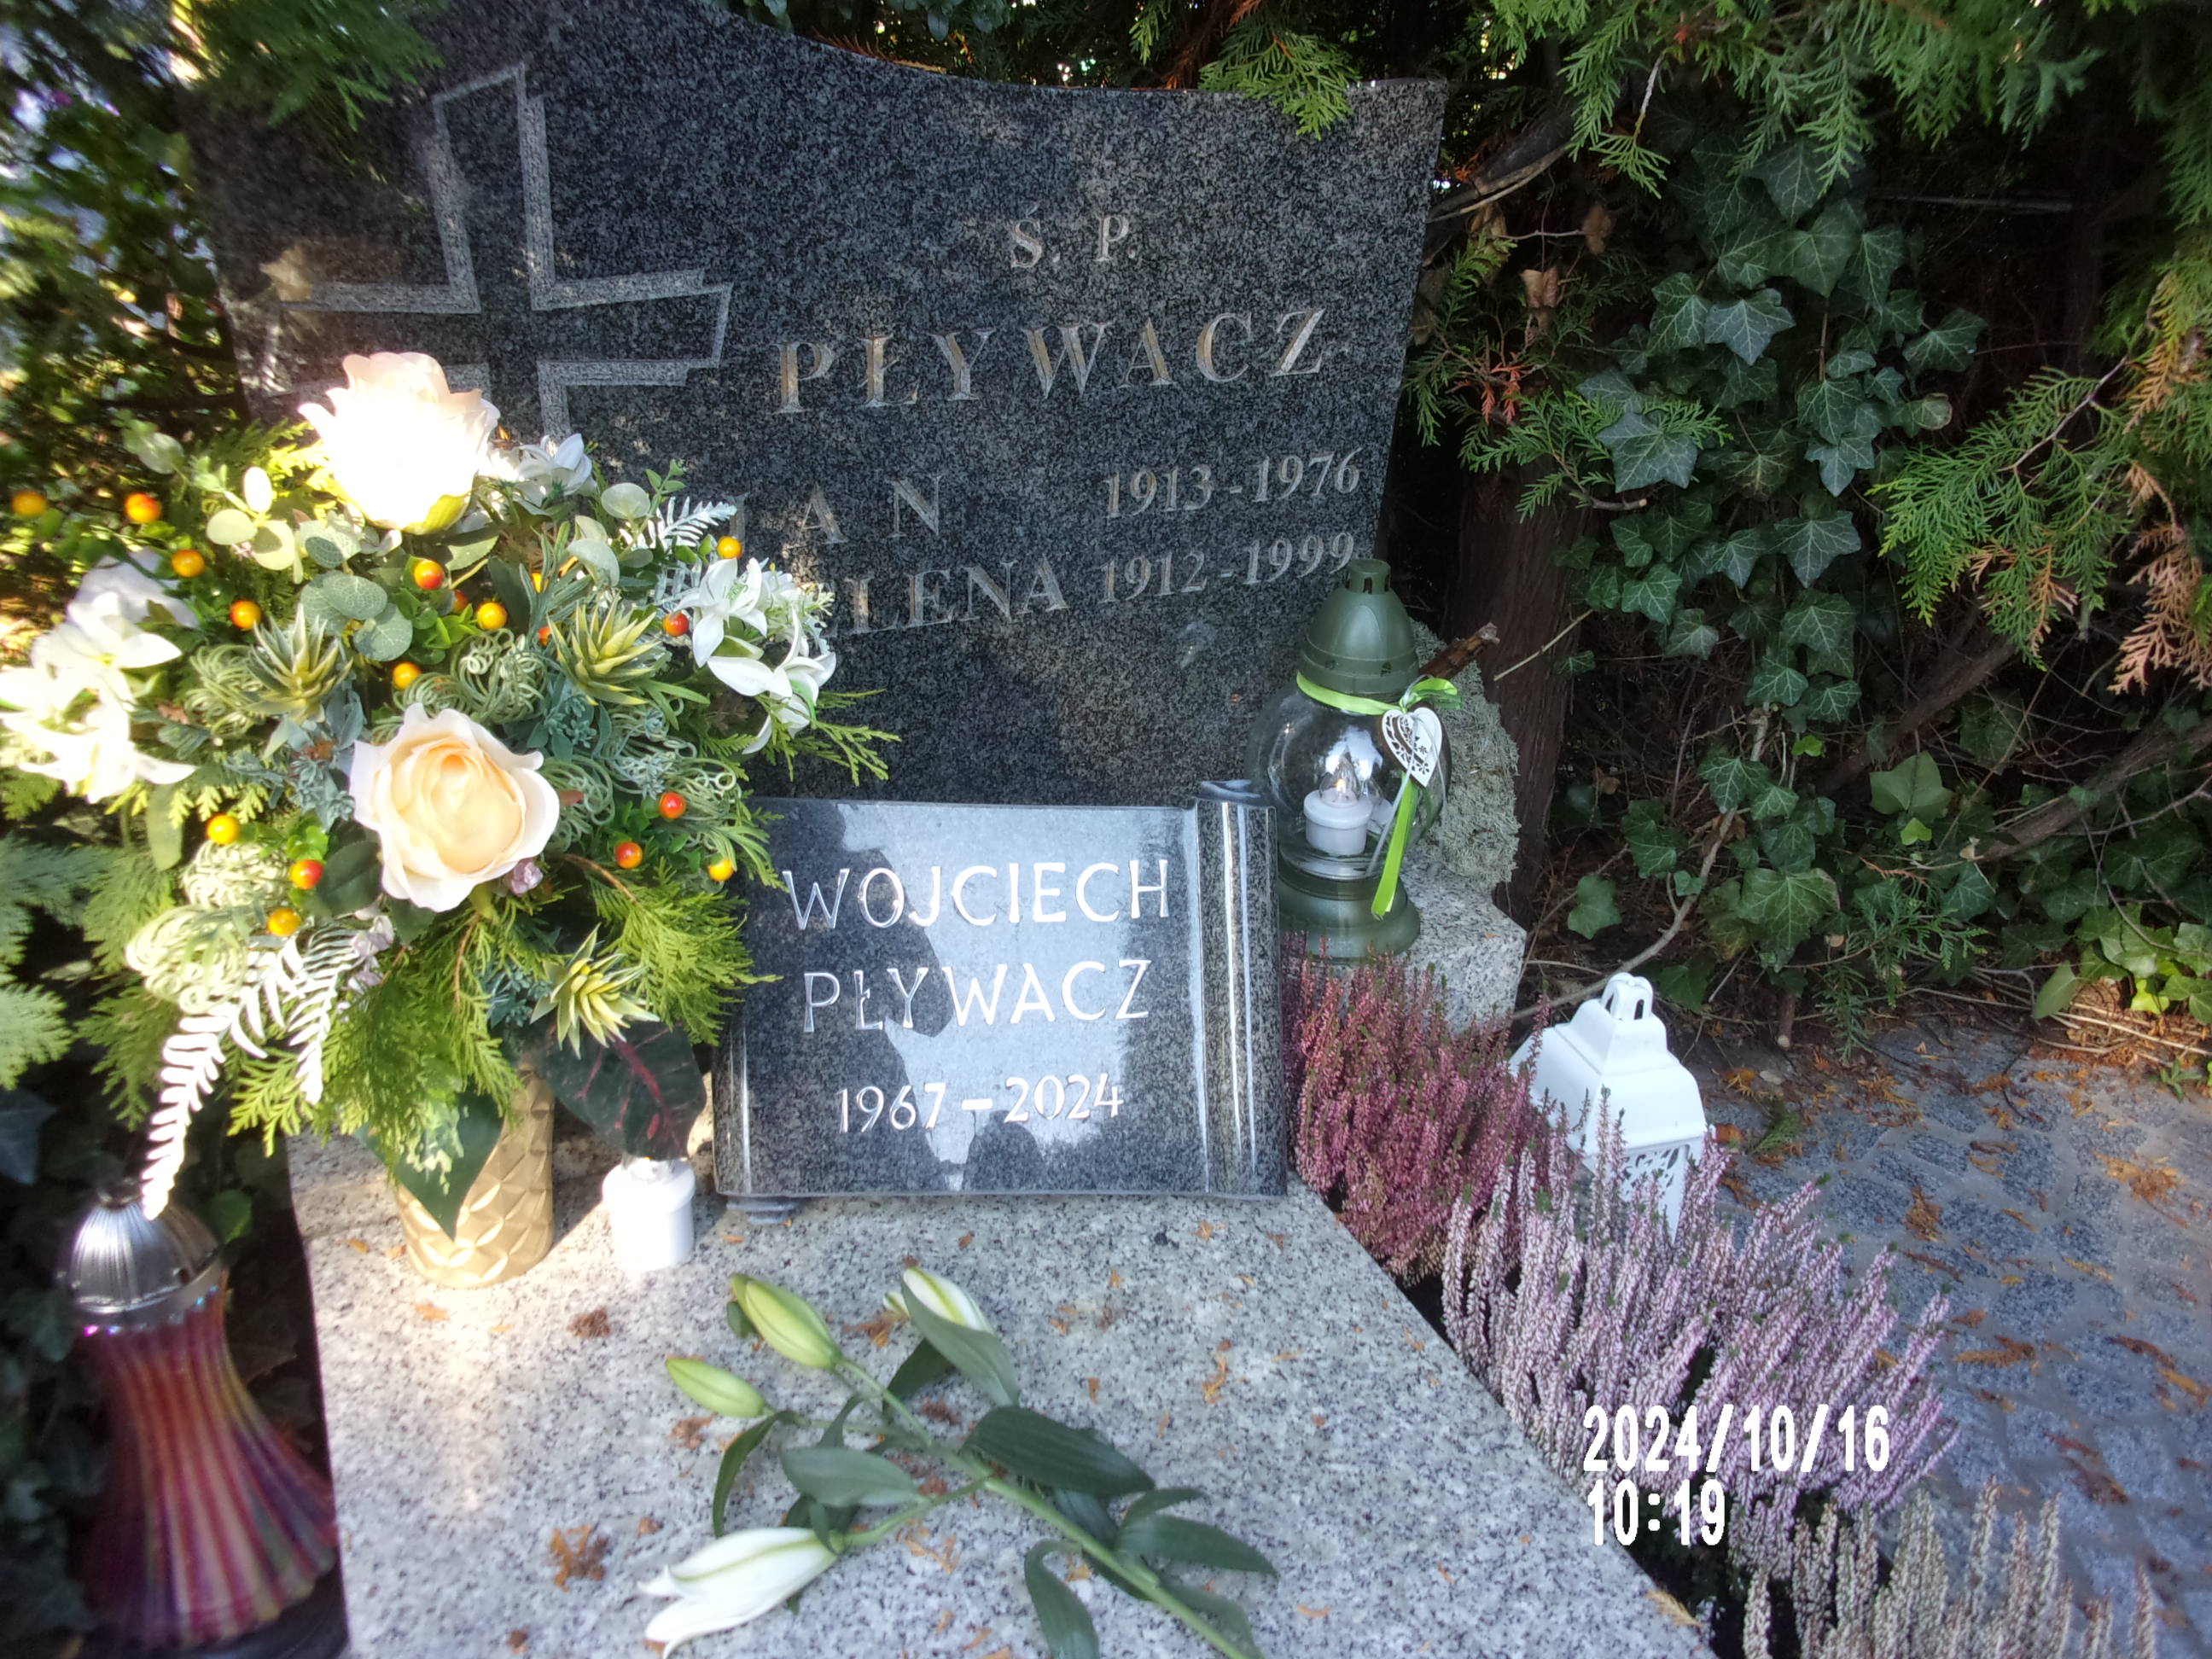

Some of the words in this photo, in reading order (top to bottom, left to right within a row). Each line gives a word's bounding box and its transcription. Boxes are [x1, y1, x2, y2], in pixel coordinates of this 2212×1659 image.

[771, 306, 1327, 415] PŁYWACZ
[822, 554, 1070, 638] LENA
[782, 859, 1169, 931] WOJCIECH
[802, 958, 1153, 1033] PŁYWACZ
